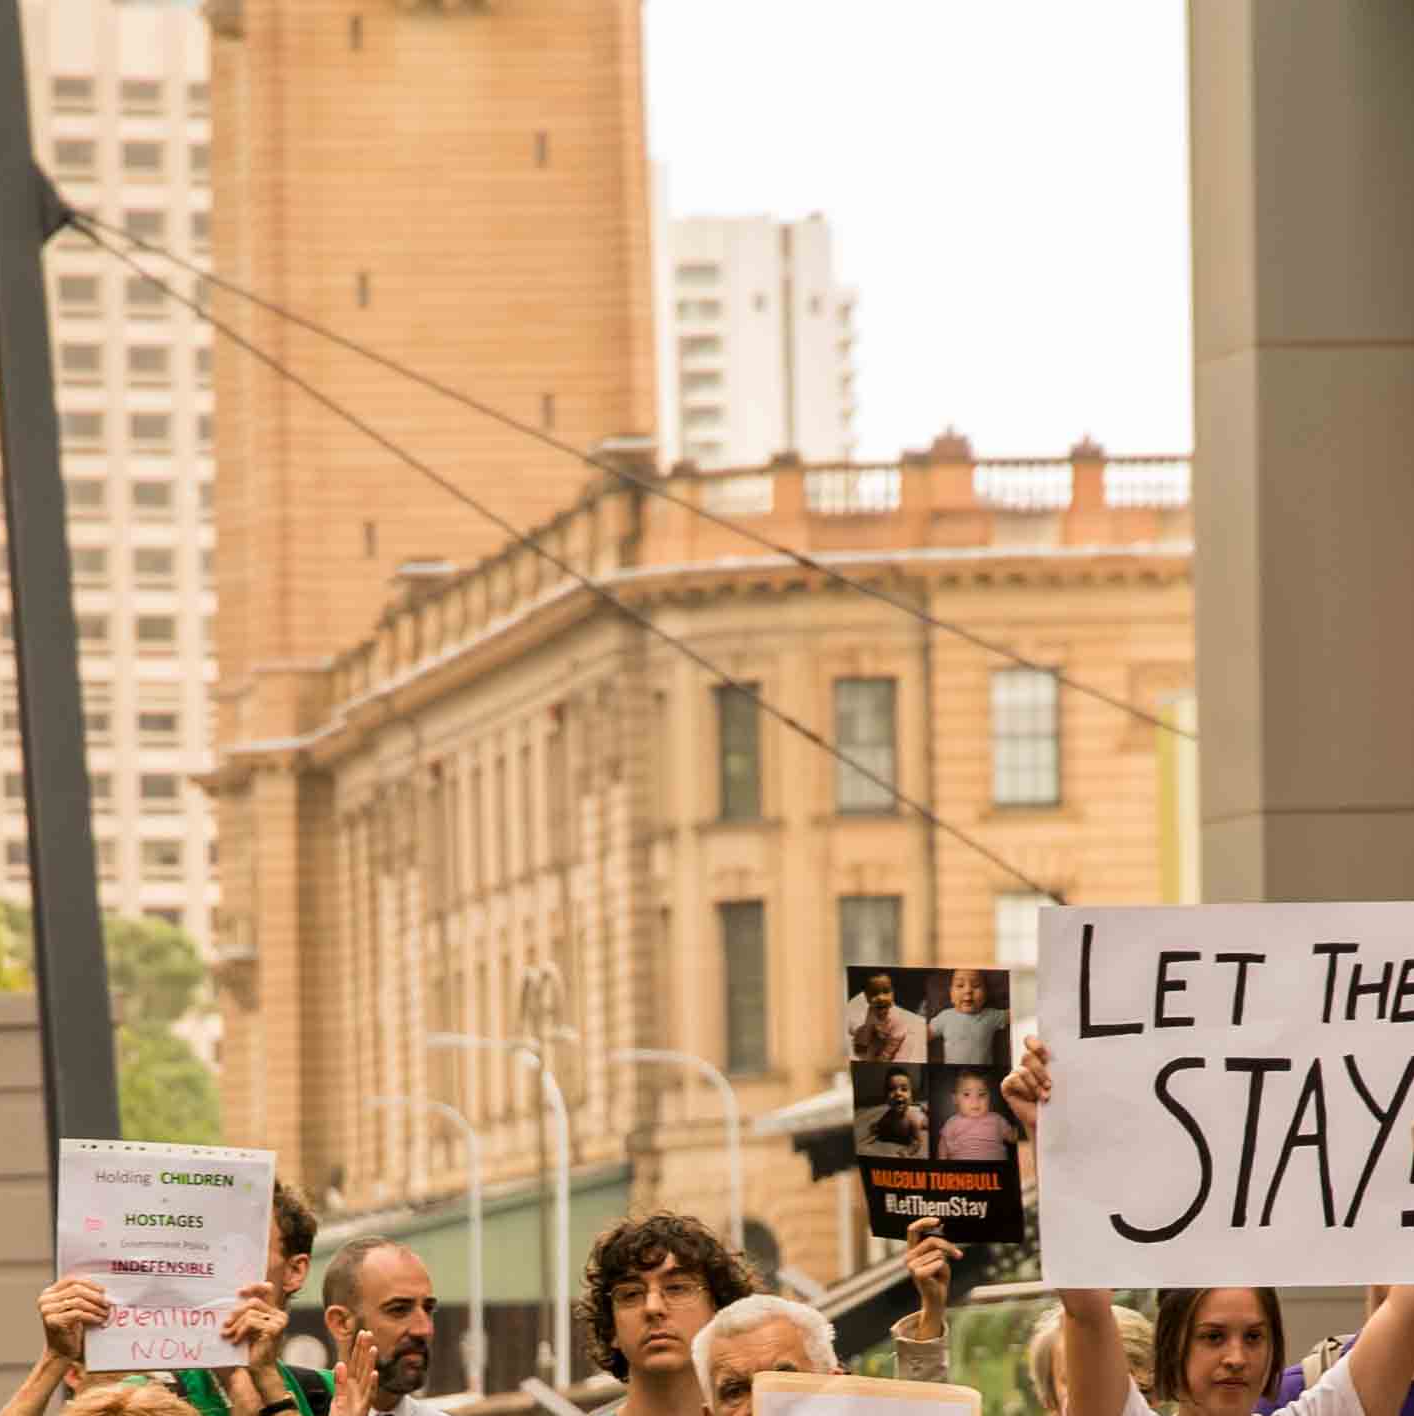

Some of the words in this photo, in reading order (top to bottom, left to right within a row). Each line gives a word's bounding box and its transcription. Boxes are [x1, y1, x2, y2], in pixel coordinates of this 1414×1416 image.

[1079, 923, 1267, 1040] LET
[95, 1169, 153, 1187] Holding
[160, 1171, 235, 1188] CHILDREN
[871, 1167, 928, 1189] MALCOLM
[930, 1171, 1003, 1190] TURNBULL
[884, 1193, 989, 1219] #LetThemStay
[124, 1213, 204, 1229] HOSTAGES
[110, 1259, 215, 1275] INDEFENSIBLE
[131, 1337, 203, 1361] NOW
